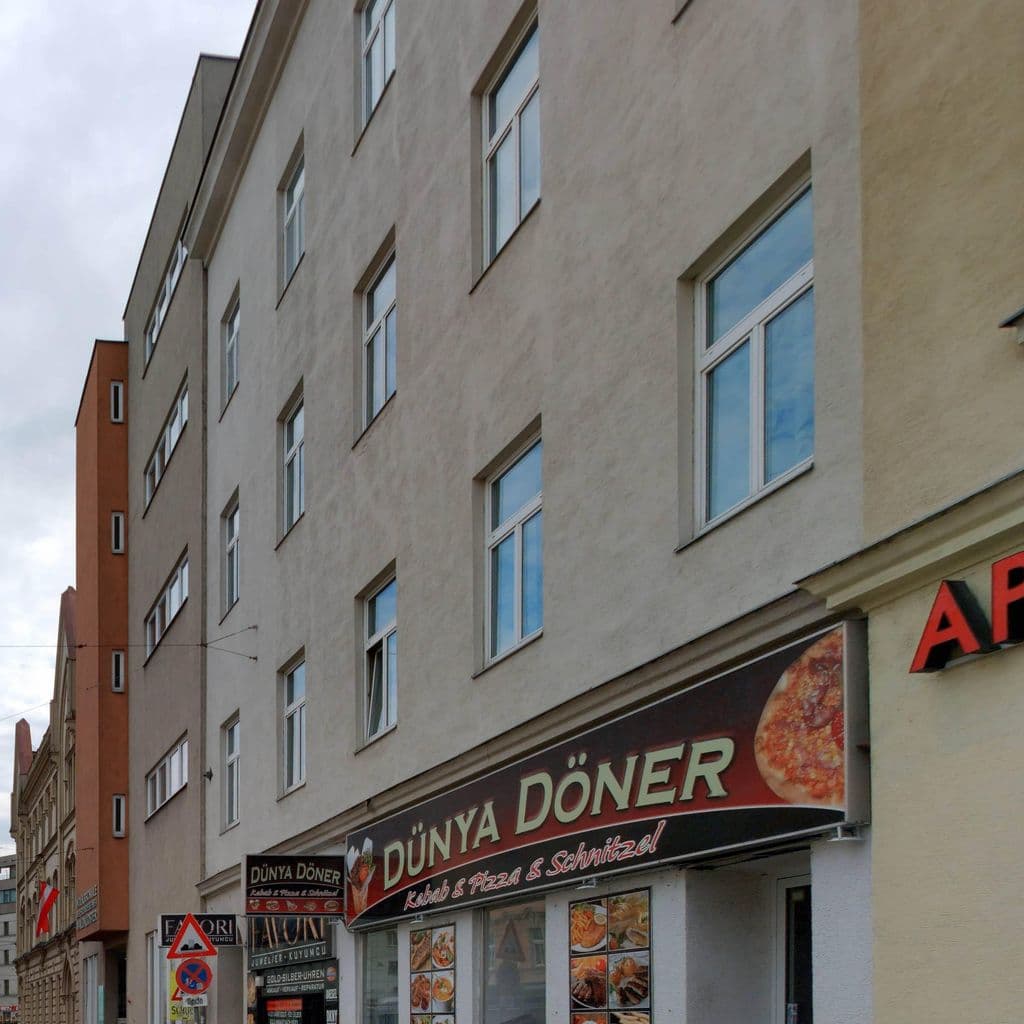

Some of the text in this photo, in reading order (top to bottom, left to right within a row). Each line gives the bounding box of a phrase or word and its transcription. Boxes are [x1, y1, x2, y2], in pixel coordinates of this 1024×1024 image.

[384, 737, 734, 891] DÜNYA DÖNER
[251, 862, 341, 885] DÜNYA DÖNER
[404, 819, 666, 911] Kebab & Pizza & Schnitzel
[251, 953, 283, 967] JUWELIER
